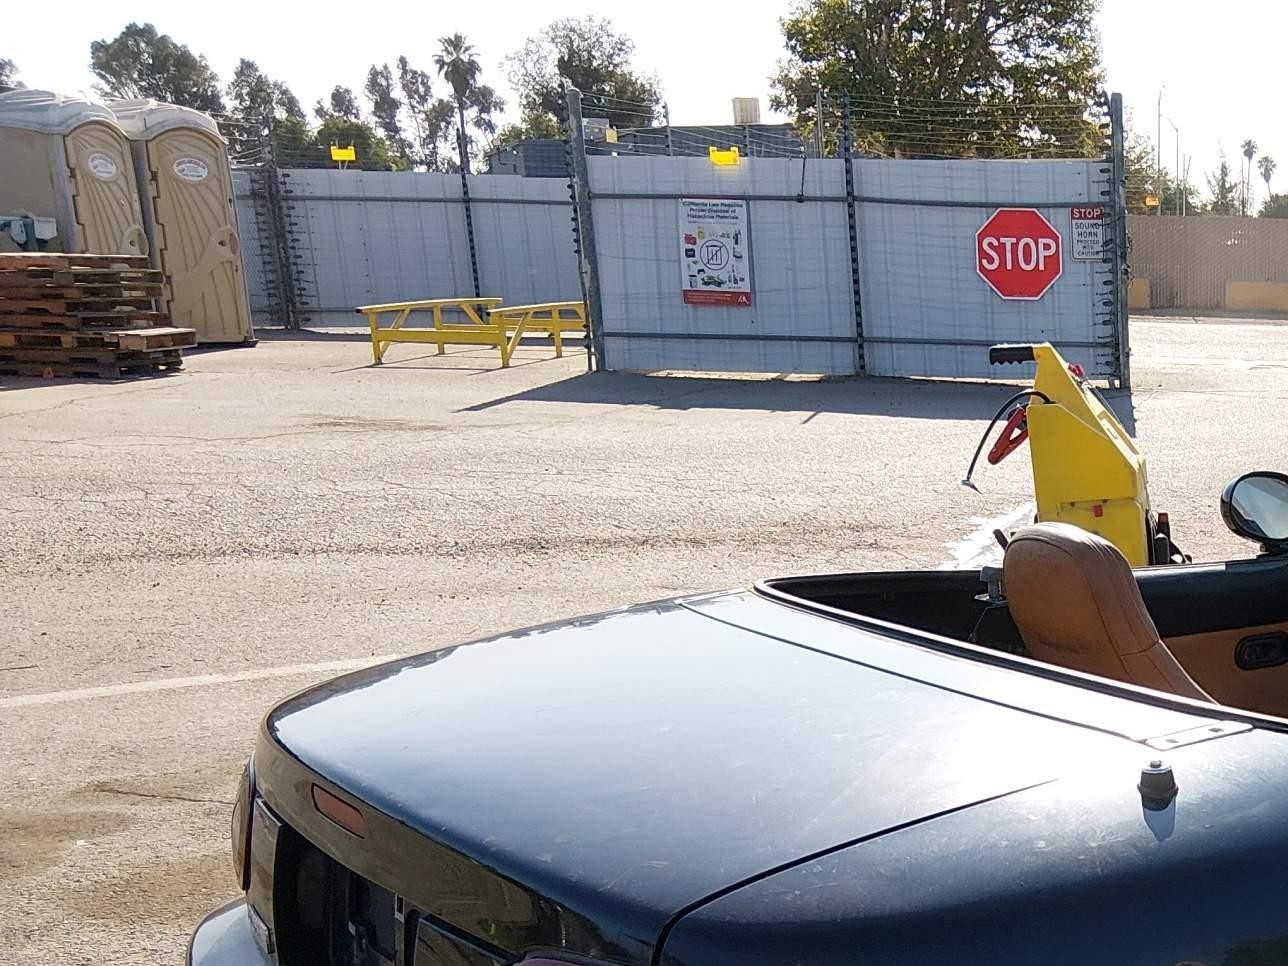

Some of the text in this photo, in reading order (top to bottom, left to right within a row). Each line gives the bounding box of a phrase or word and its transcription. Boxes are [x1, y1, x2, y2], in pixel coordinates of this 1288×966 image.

[1073, 208, 1101, 218] STOP
[1074, 222, 1100, 230] SOUND
[981, 236, 1057, 271] STOP
